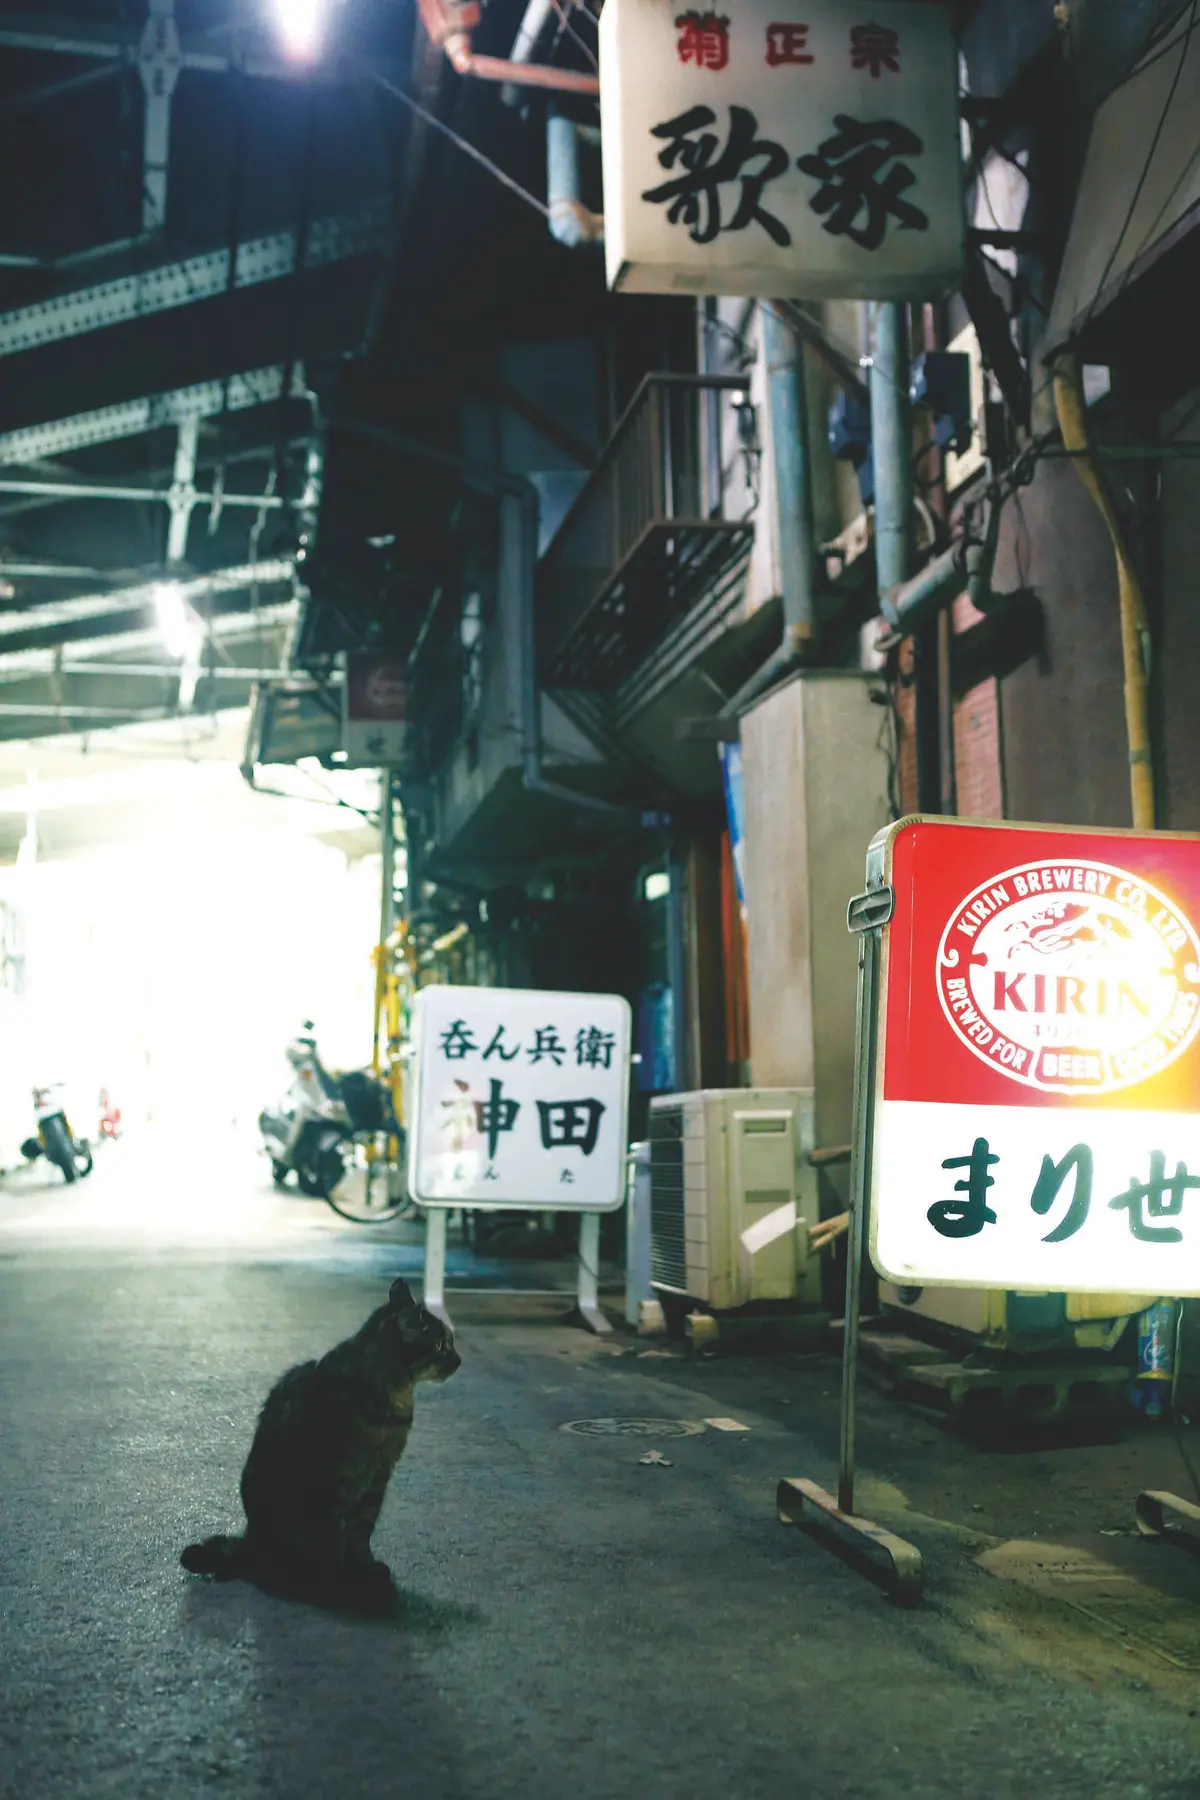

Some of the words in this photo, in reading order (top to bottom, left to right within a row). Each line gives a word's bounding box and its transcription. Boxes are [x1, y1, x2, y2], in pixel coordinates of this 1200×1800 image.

[674, 9, 901, 78] 菊正宗
[641, 105, 929, 251] 歌家
[957, 884, 1010, 937] KIRIN
[1013, 868, 1112, 898] BREWERY
[946, 977, 994, 1045] BREWED
[989, 1036, 1027, 1070] FOR
[993, 971, 1149, 1017] KIRIN
[438, 1018, 617, 1070] 呑ん兵衛
[1042, 1053, 1101, 1079] BEER
